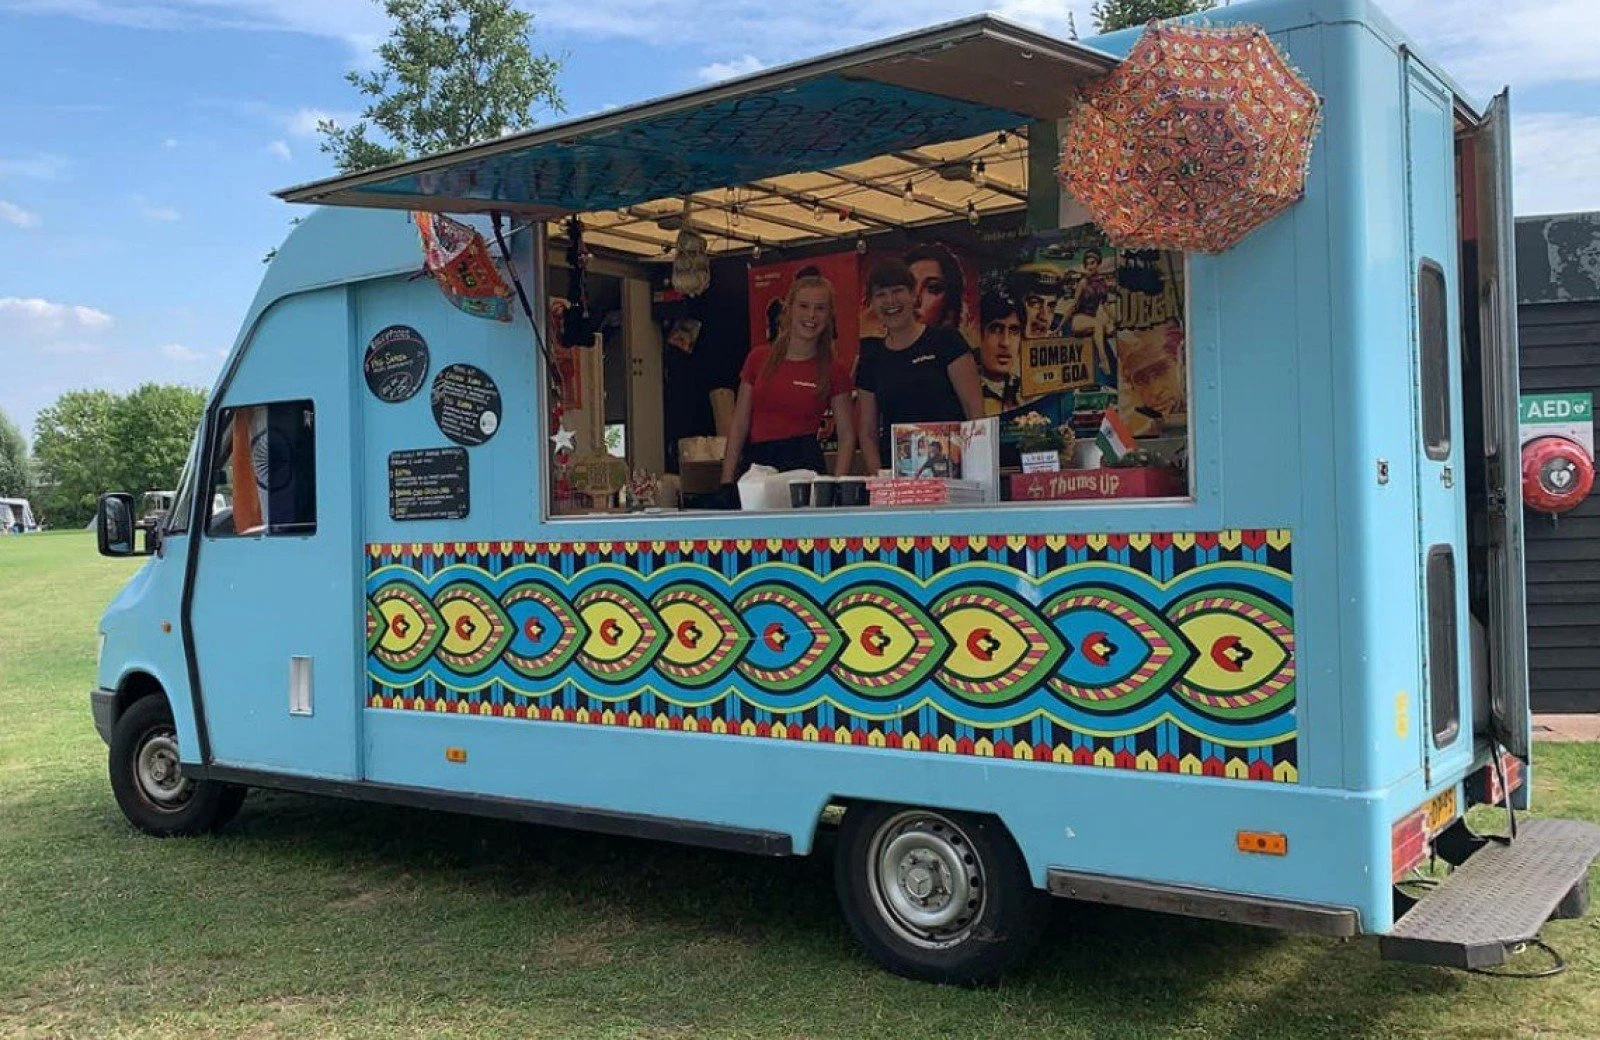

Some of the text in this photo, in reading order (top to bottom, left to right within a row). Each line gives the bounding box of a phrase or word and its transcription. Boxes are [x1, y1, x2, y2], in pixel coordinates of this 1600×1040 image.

[1030, 345, 1084, 368] BOMBAY
[1062, 363, 1089, 384] GOA
[1527, 400, 1571, 418] AED
